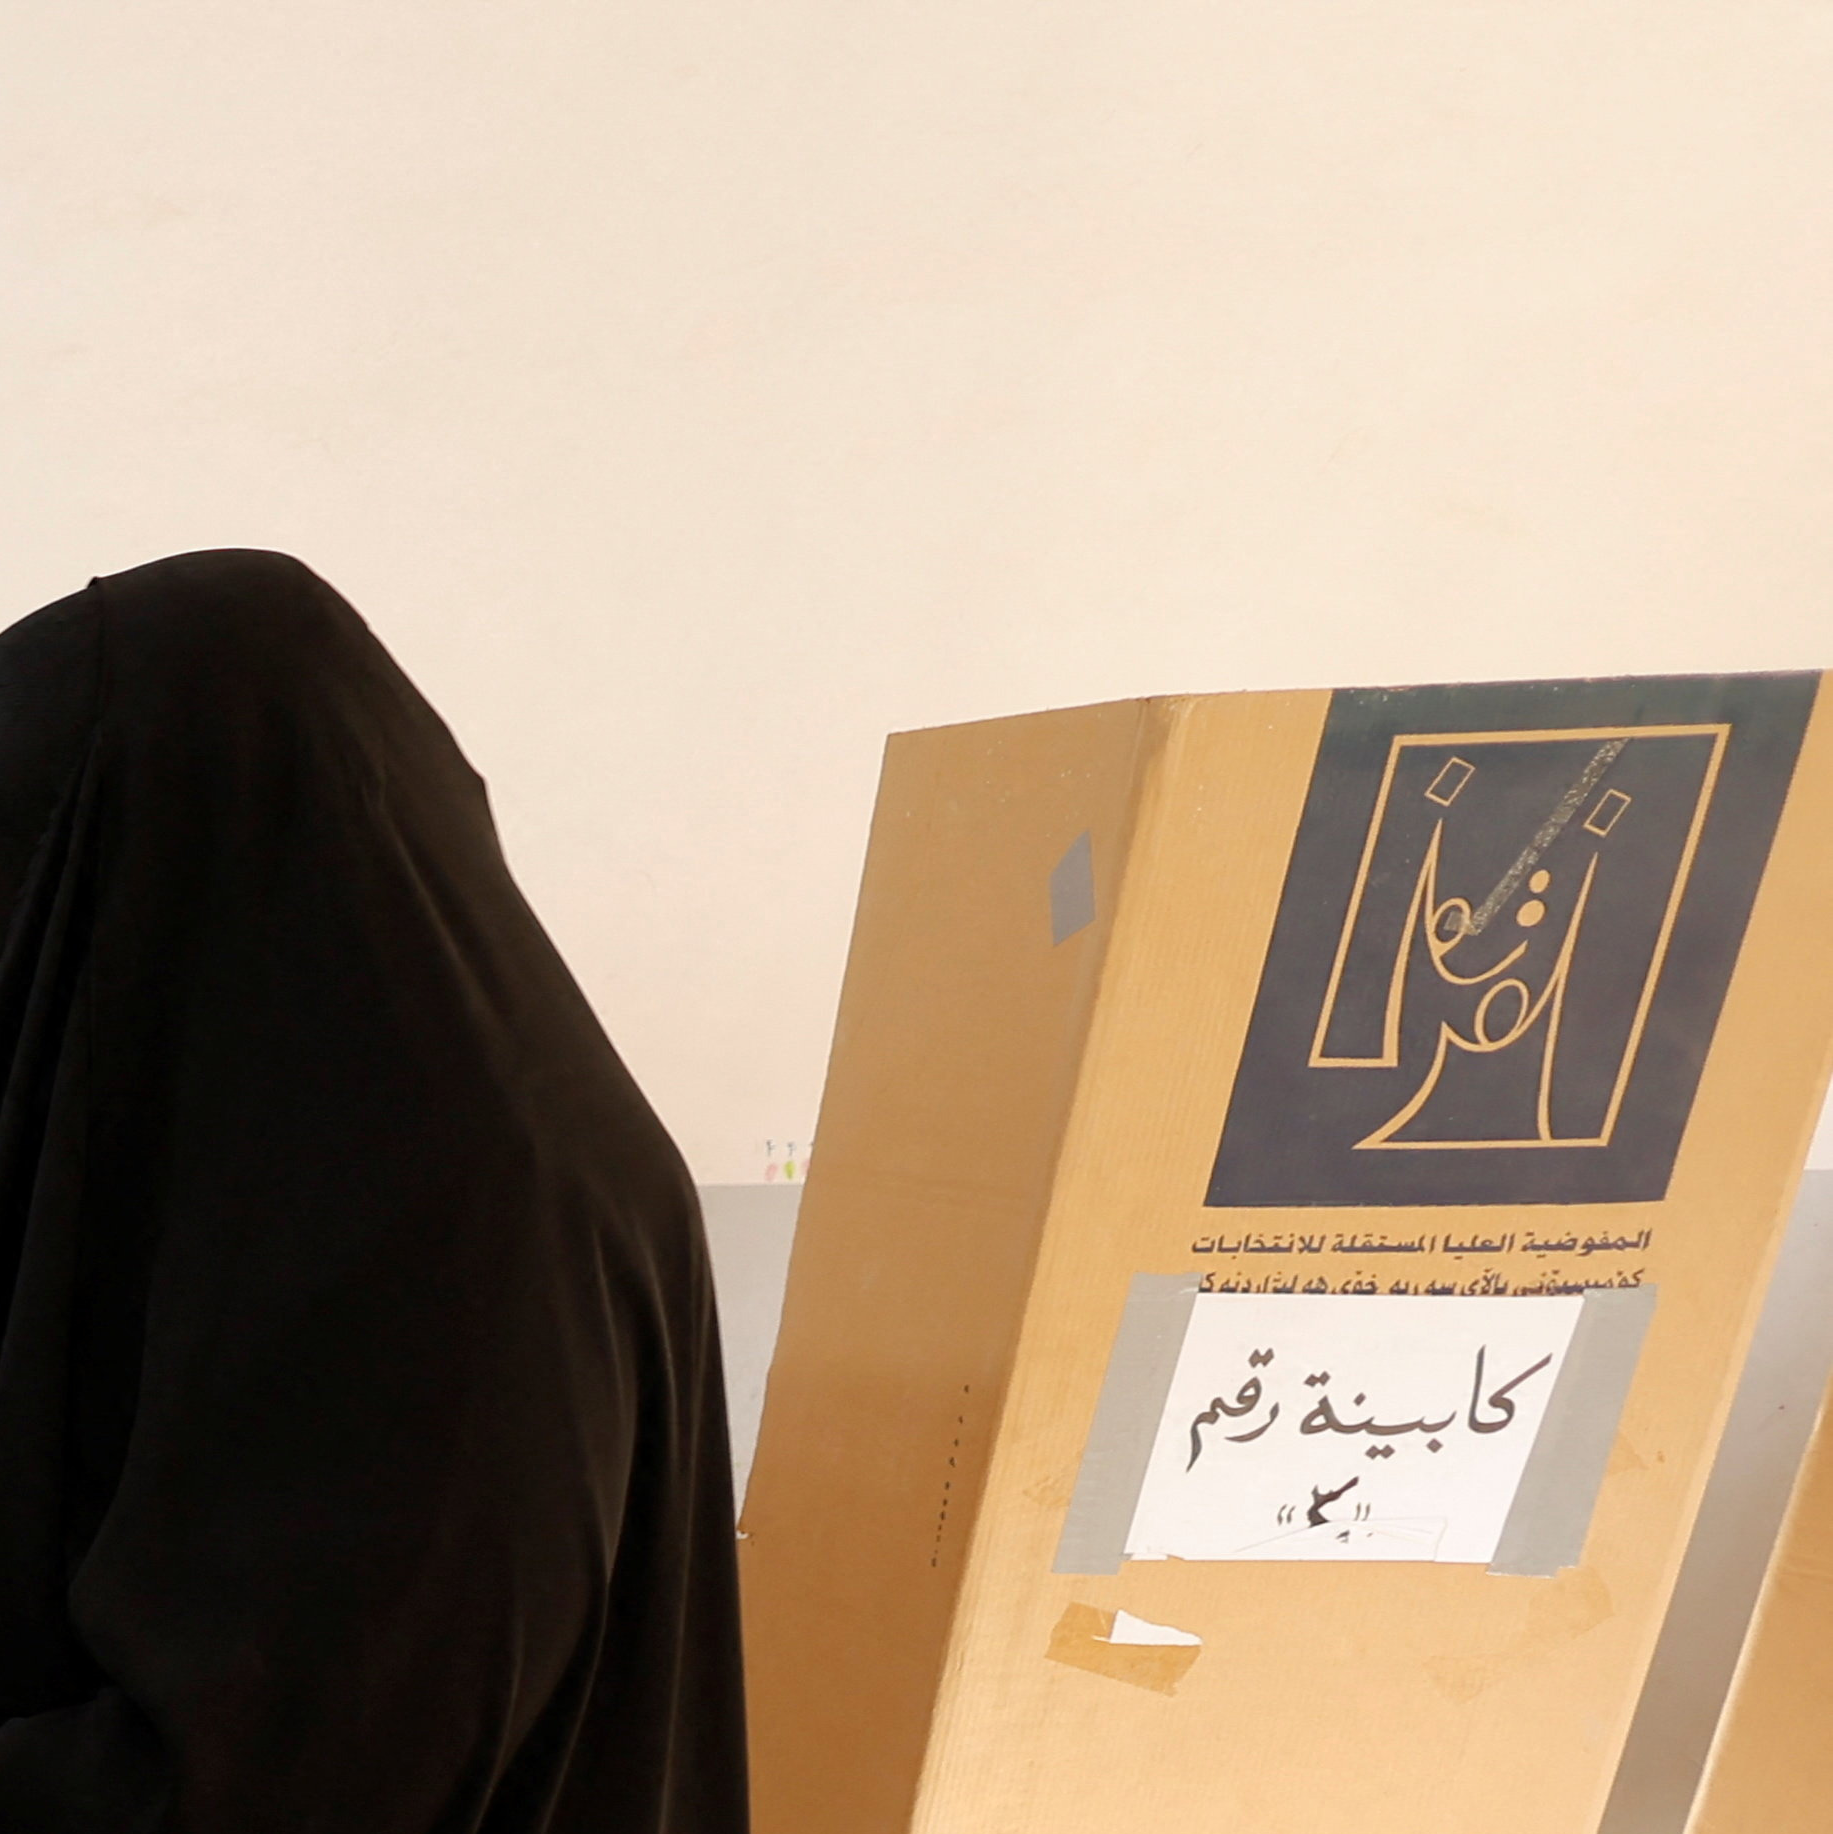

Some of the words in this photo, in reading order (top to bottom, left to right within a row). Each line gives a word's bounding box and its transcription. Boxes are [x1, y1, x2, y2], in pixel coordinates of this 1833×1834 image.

[1191, 1234, 1326, 1260] للانتخابات
[1331, 1234, 1434, 1254] المستقلة
[1442, 1233, 1515, 1260] العليا
[1520, 1228, 1652, 1257] المفوضية
[1186, 1347, 1280, 1474] رقم
[1299, 1343, 1553, 1460] كابينة
